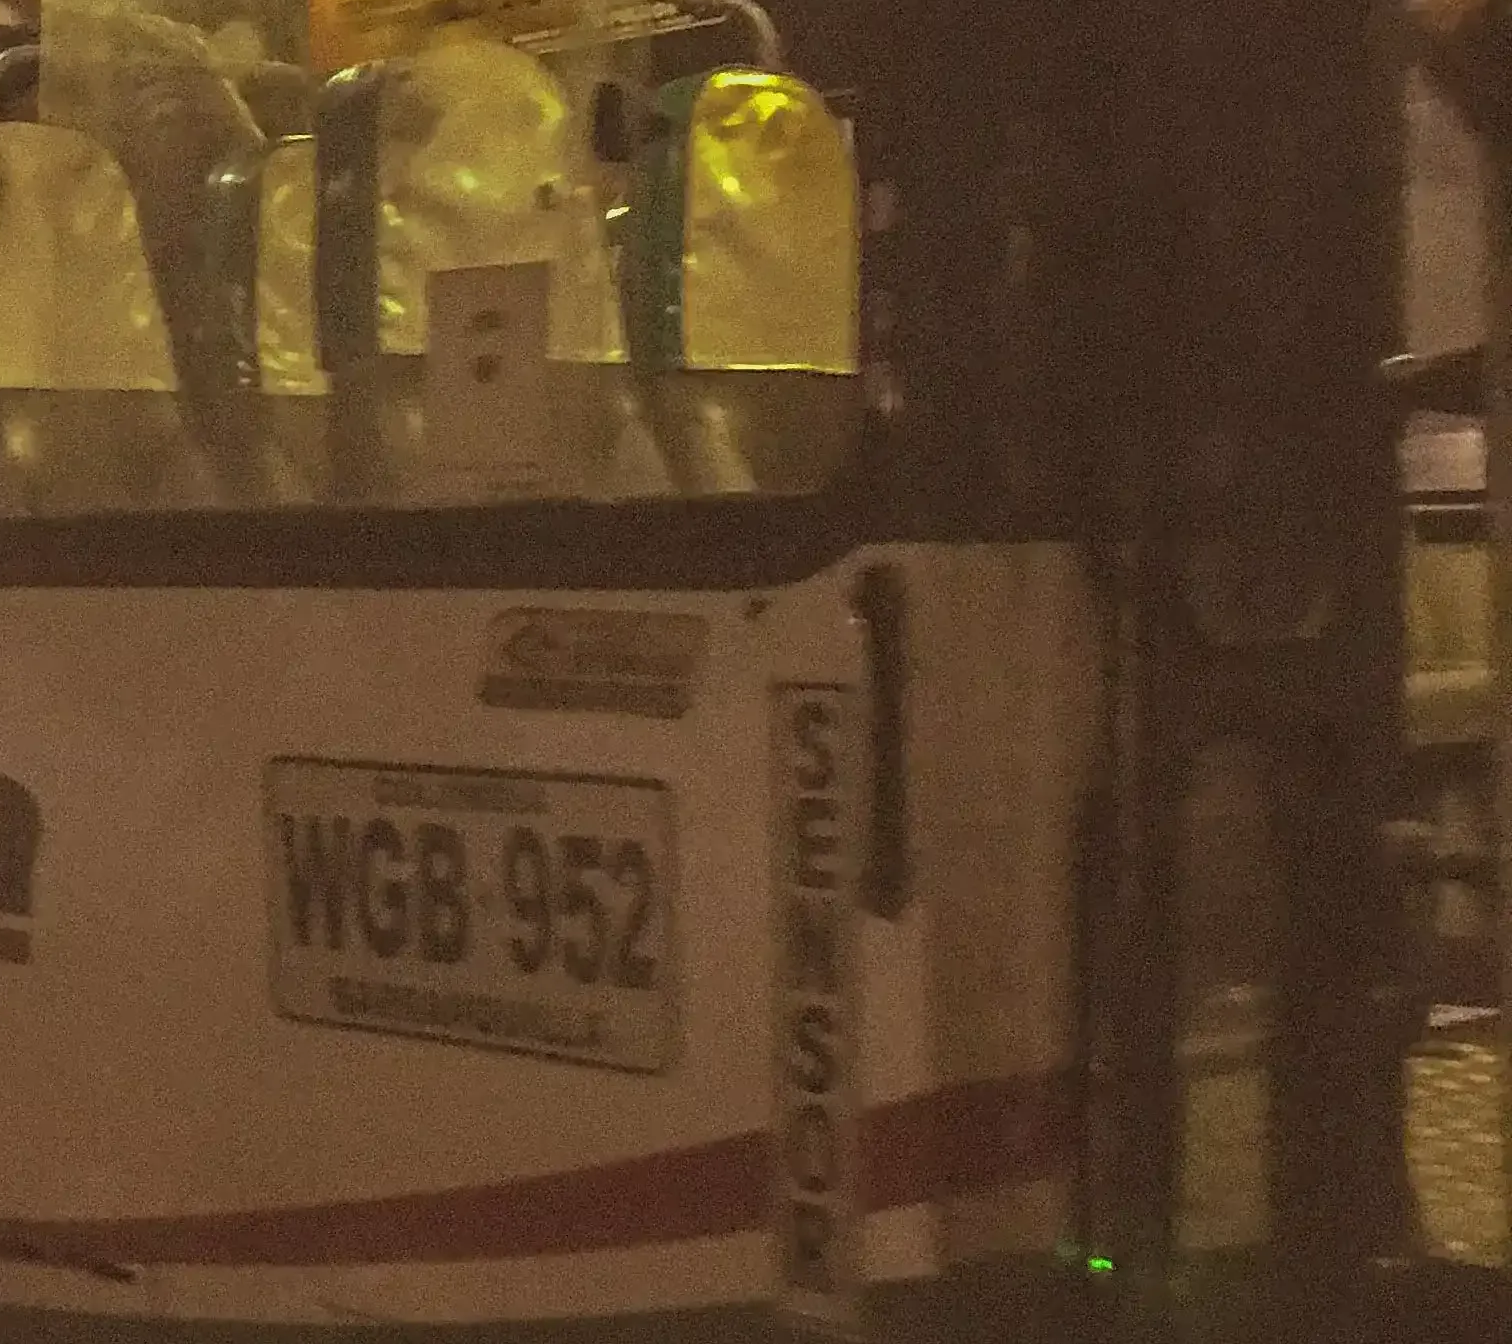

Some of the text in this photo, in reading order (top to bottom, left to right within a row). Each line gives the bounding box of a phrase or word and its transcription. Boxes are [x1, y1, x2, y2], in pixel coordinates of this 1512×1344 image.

[278, 813, 659, 989] WGB 952
[792, 700, 839, 1294] SENSOR
